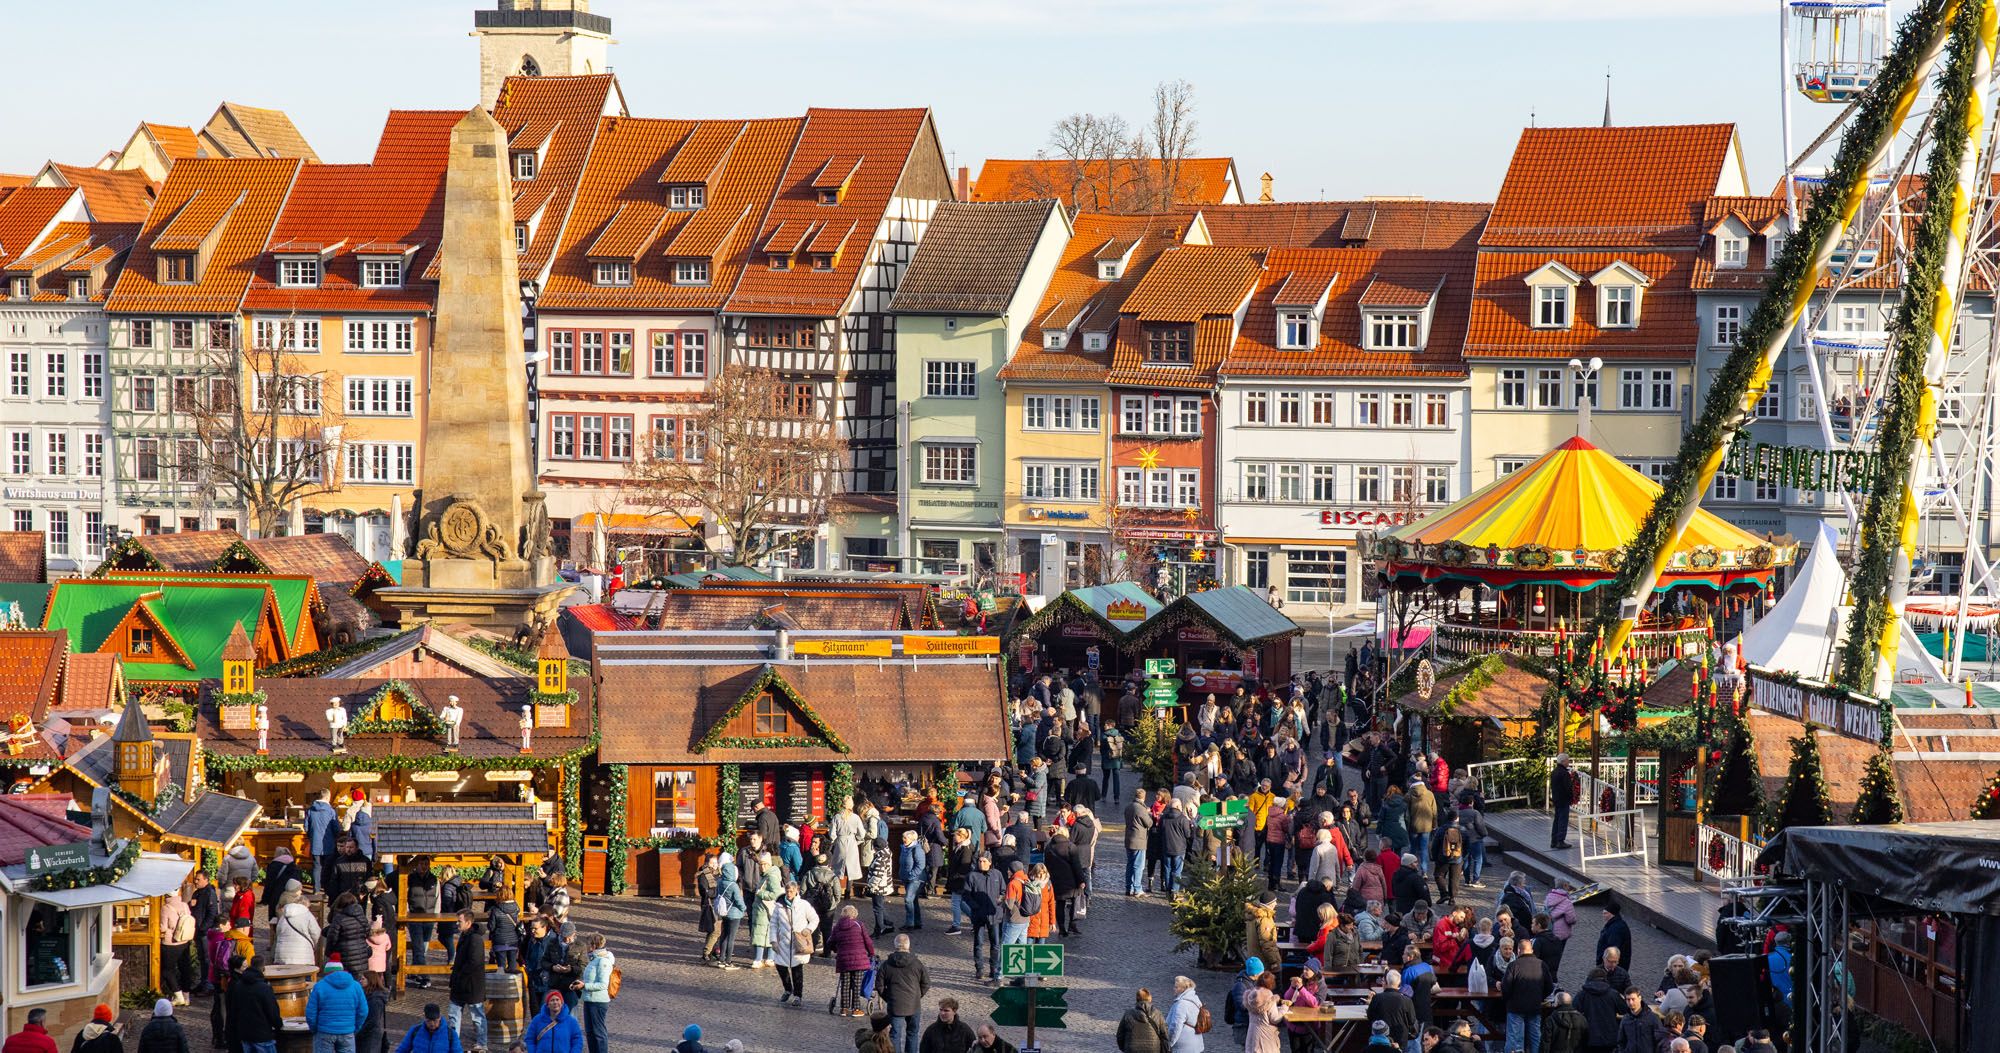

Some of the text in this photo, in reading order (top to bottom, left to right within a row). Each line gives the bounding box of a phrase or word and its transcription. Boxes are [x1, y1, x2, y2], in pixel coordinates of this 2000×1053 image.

[7, 487, 60, 498] Wirtshaus
[61, 491, 77, 499] am
[941, 589, 954, 599] Hot
[927, 640, 977, 652] Hüttengrill
[1808, 693, 1838, 728] GRILL
[43, 855, 86, 868] Wackerbarth
